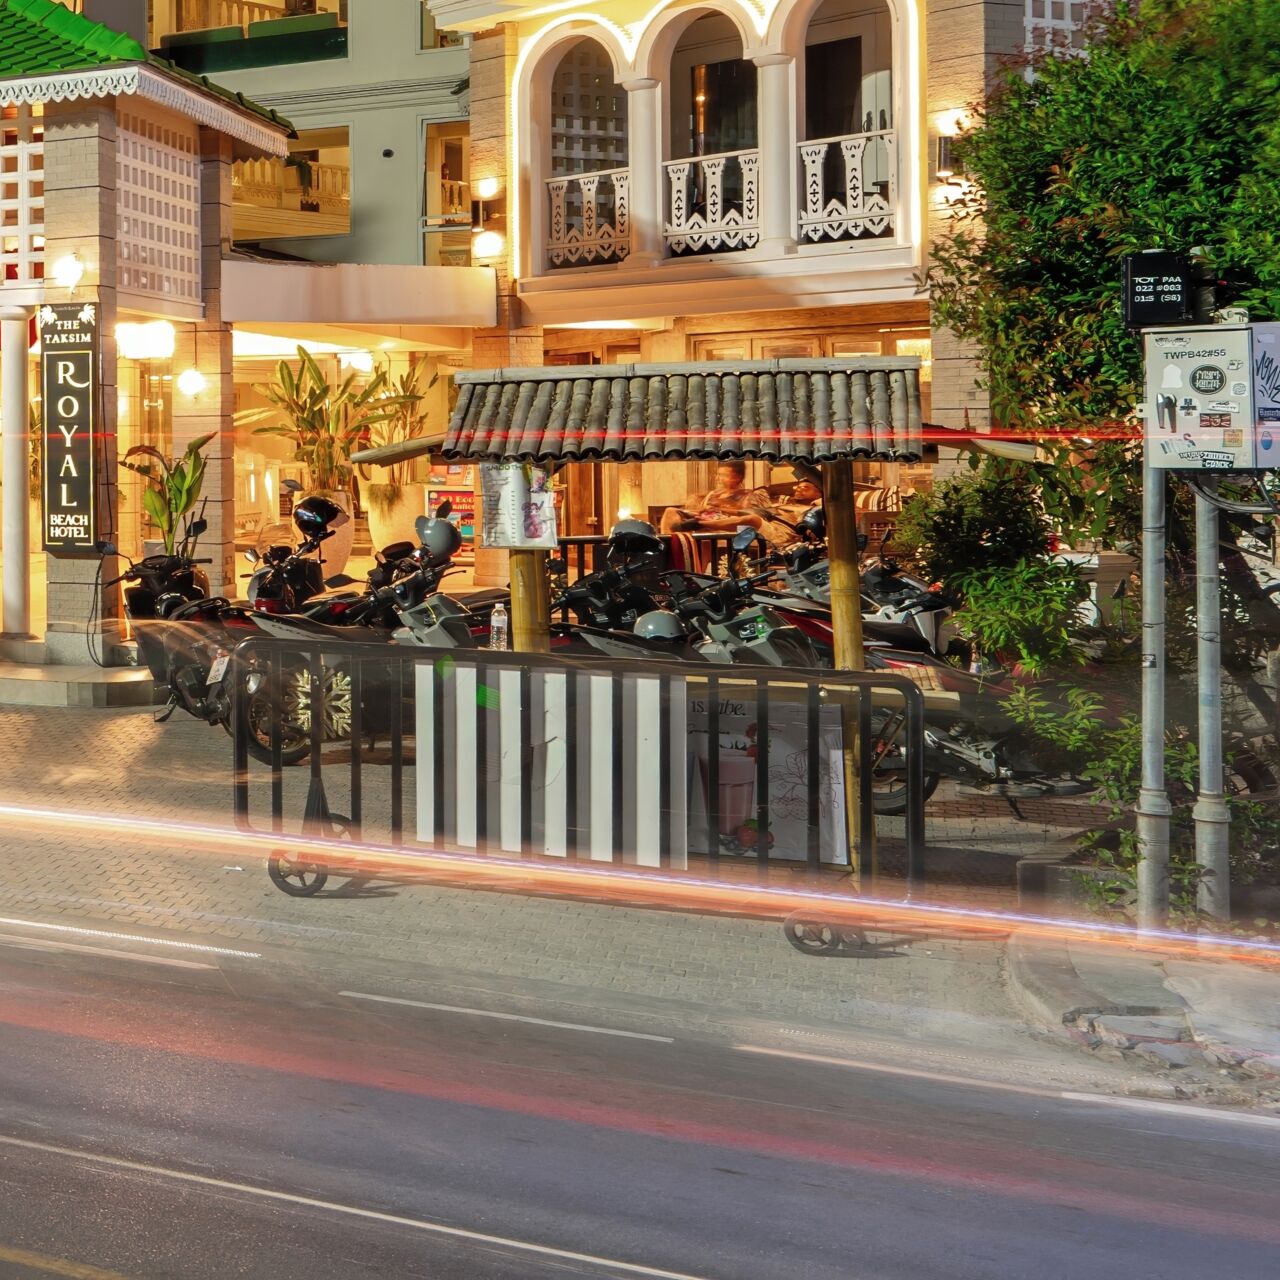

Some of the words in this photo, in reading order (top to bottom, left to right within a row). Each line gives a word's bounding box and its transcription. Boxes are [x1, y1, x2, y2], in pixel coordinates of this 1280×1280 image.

[54, 320, 81, 330] THE
[44, 333, 92, 344] TAKSIM
[57, 361, 90, 506] ROYAL
[50, 514, 89, 527] BEACH
[50, 526, 89, 538] HOTEL
